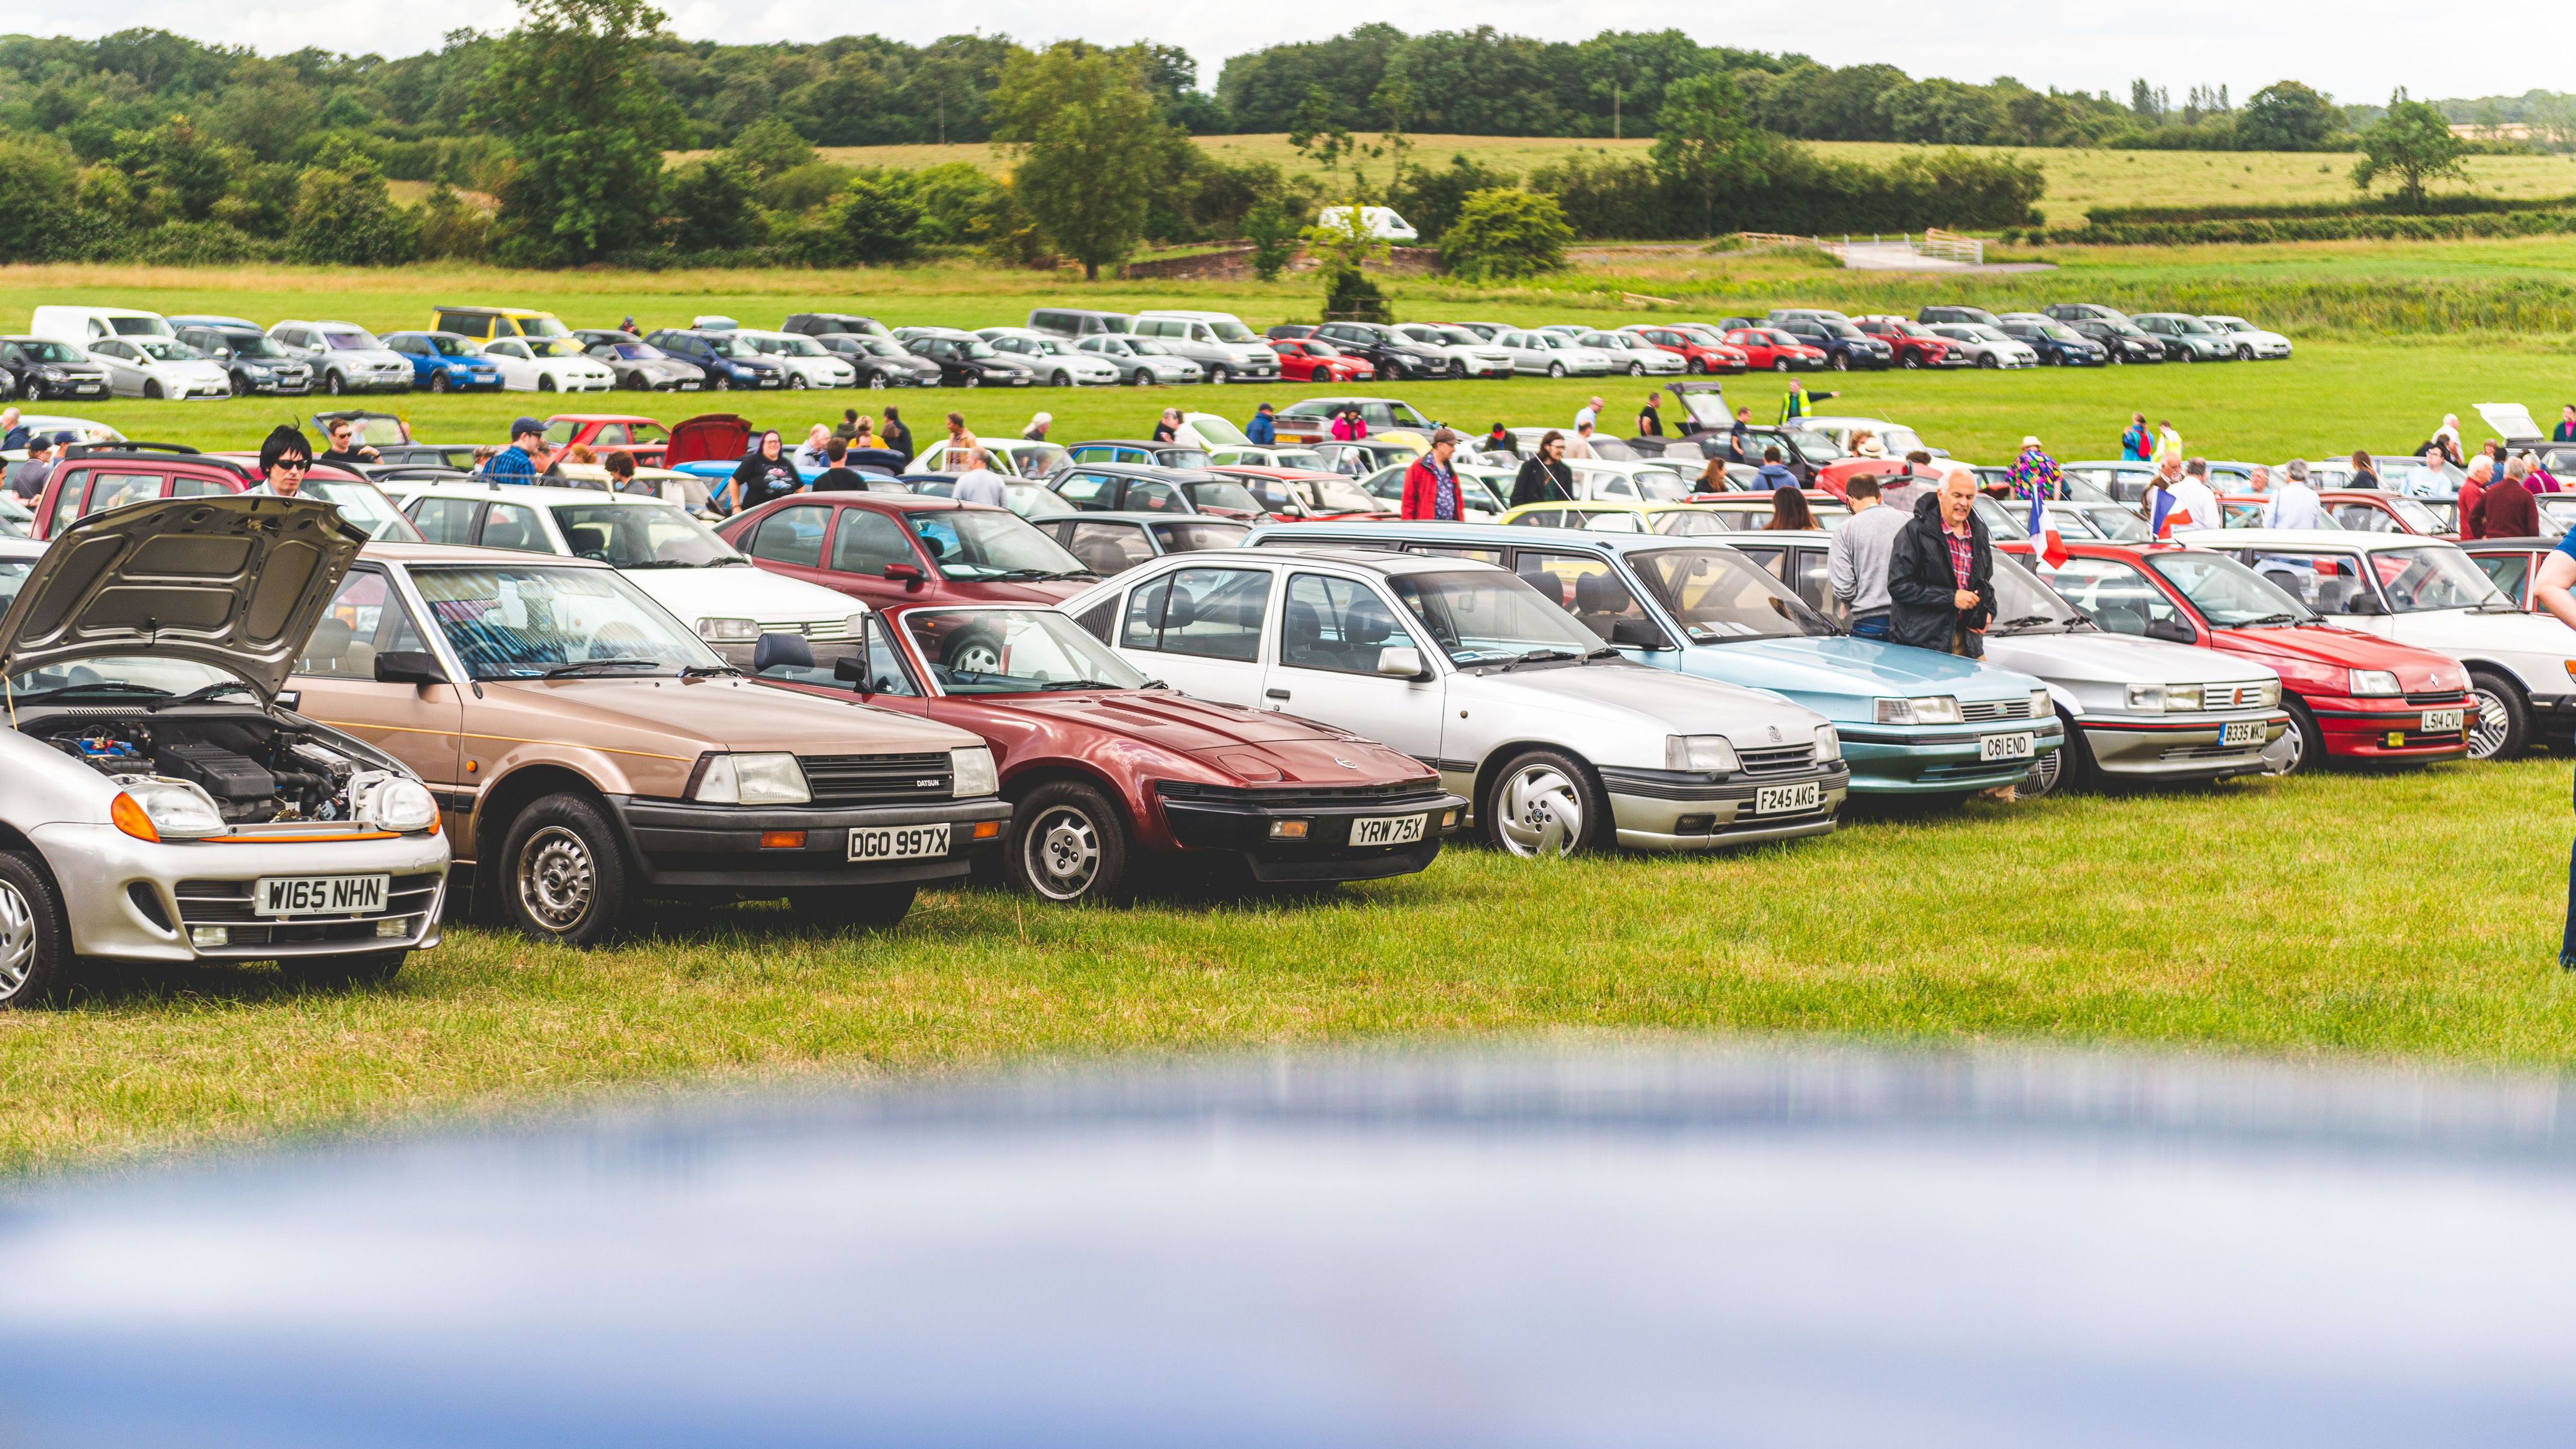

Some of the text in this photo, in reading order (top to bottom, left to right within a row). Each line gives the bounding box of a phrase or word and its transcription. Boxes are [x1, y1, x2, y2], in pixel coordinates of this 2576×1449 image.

[2424, 713, 2443, 728] L514
[2226, 725, 2249, 741] B335
[1988, 736, 2026, 756] C61 END
[1761, 786, 1814, 810] F245 AKG
[1360, 818, 1422, 842] YRW 75X
[851, 829, 948, 858] DGO 997X
[269, 878, 380, 909] W165 NHN
